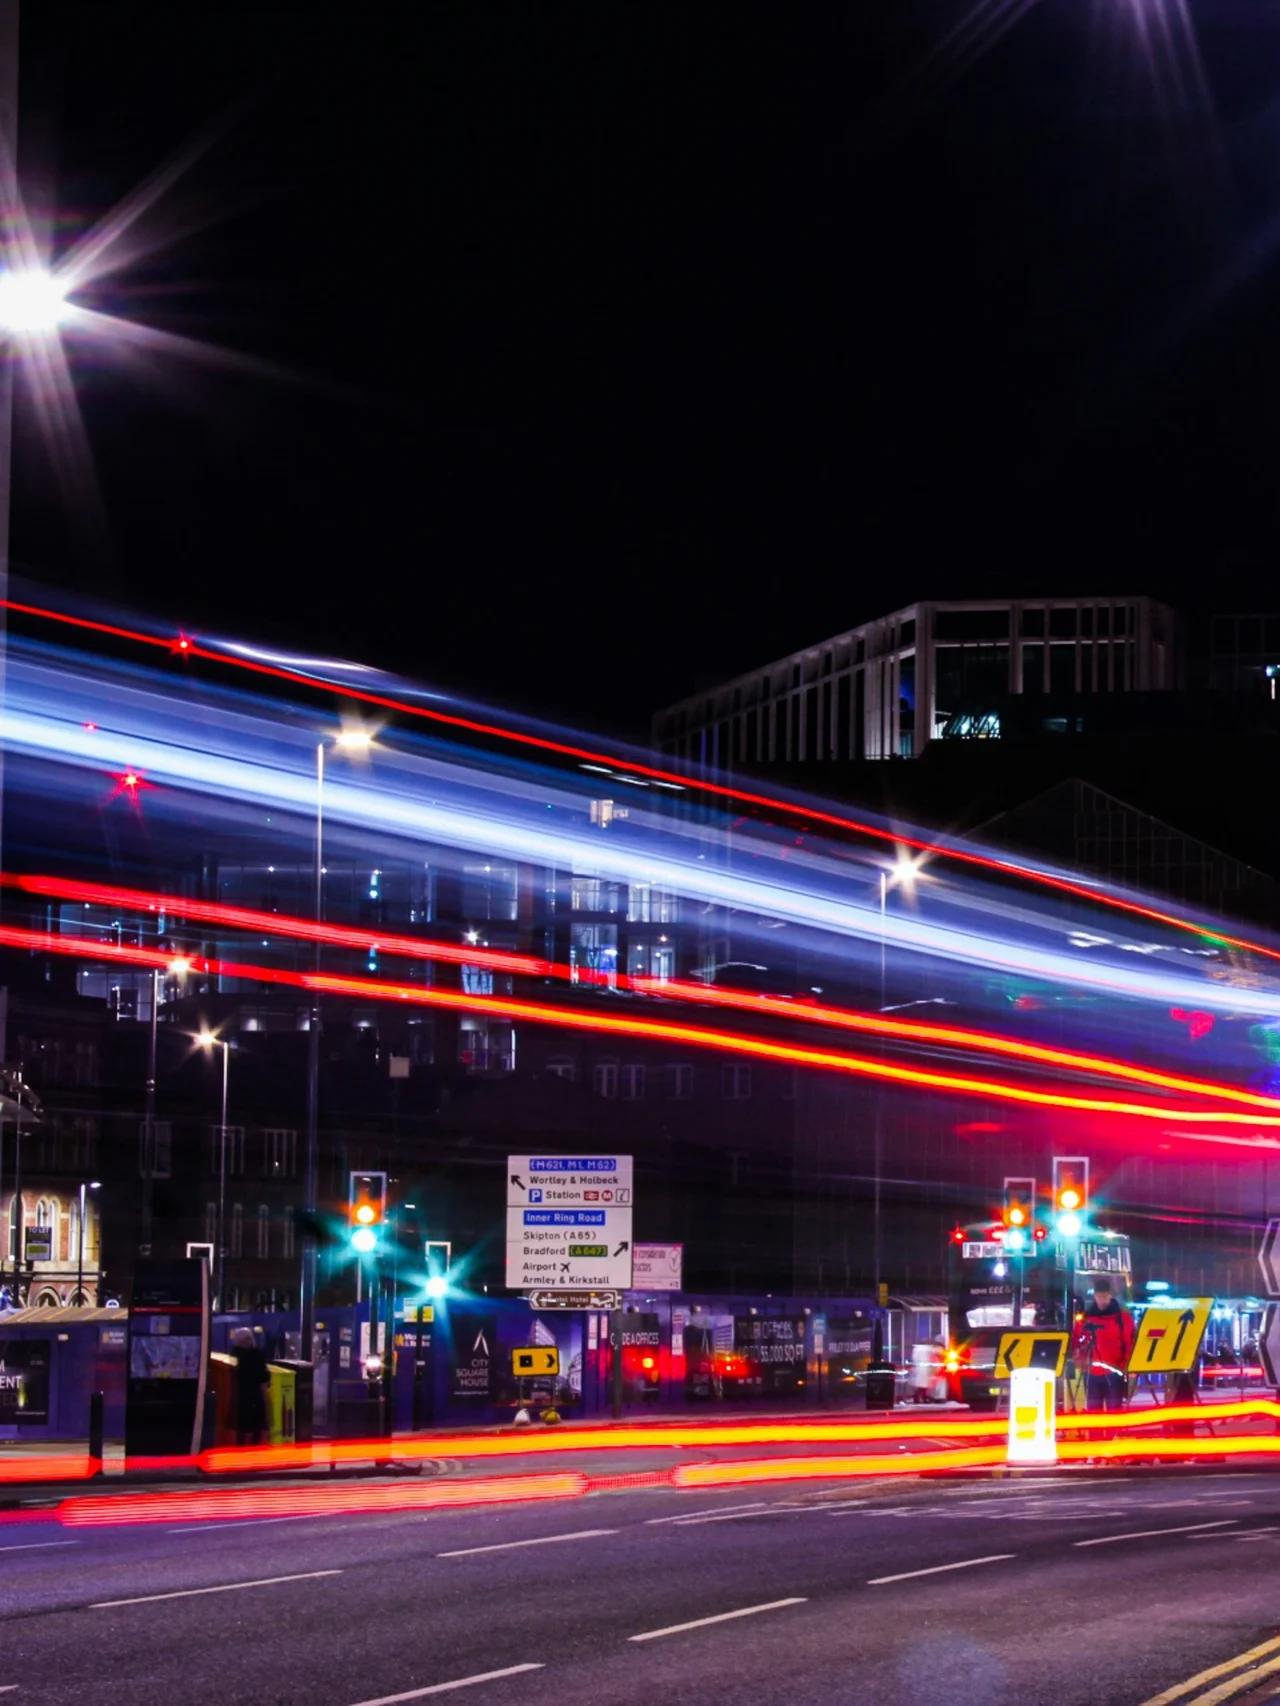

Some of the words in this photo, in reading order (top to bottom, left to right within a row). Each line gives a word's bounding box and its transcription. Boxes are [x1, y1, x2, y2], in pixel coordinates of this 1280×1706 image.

[529, 1176, 568, 1187] Wortley
[570, 1176, 576, 1185] &
[579, 1176, 619, 1185] Holbeck
[545, 1191, 581, 1200] Station
[526, 1213, 551, 1223] Inner
[554, 1213, 575, 1224] Ring
[578, 1213, 602, 1223] Road
[523, 1231, 561, 1243] Skipton
[563, 1231, 597, 1241] (A65)
[523, 1247, 566, 1256] Bradford
[523, 1262, 557, 1273] Airport
[522, 1276, 557, 1287] Armley
[559, 1276, 565, 1285] &
[568, 1275, 610, 1285] Kirkstall
[471, 1358, 489, 1368] CITY
[456, 1368, 489, 1378] SQUARE
[460, 1377, 489, 1387] HOUSE
